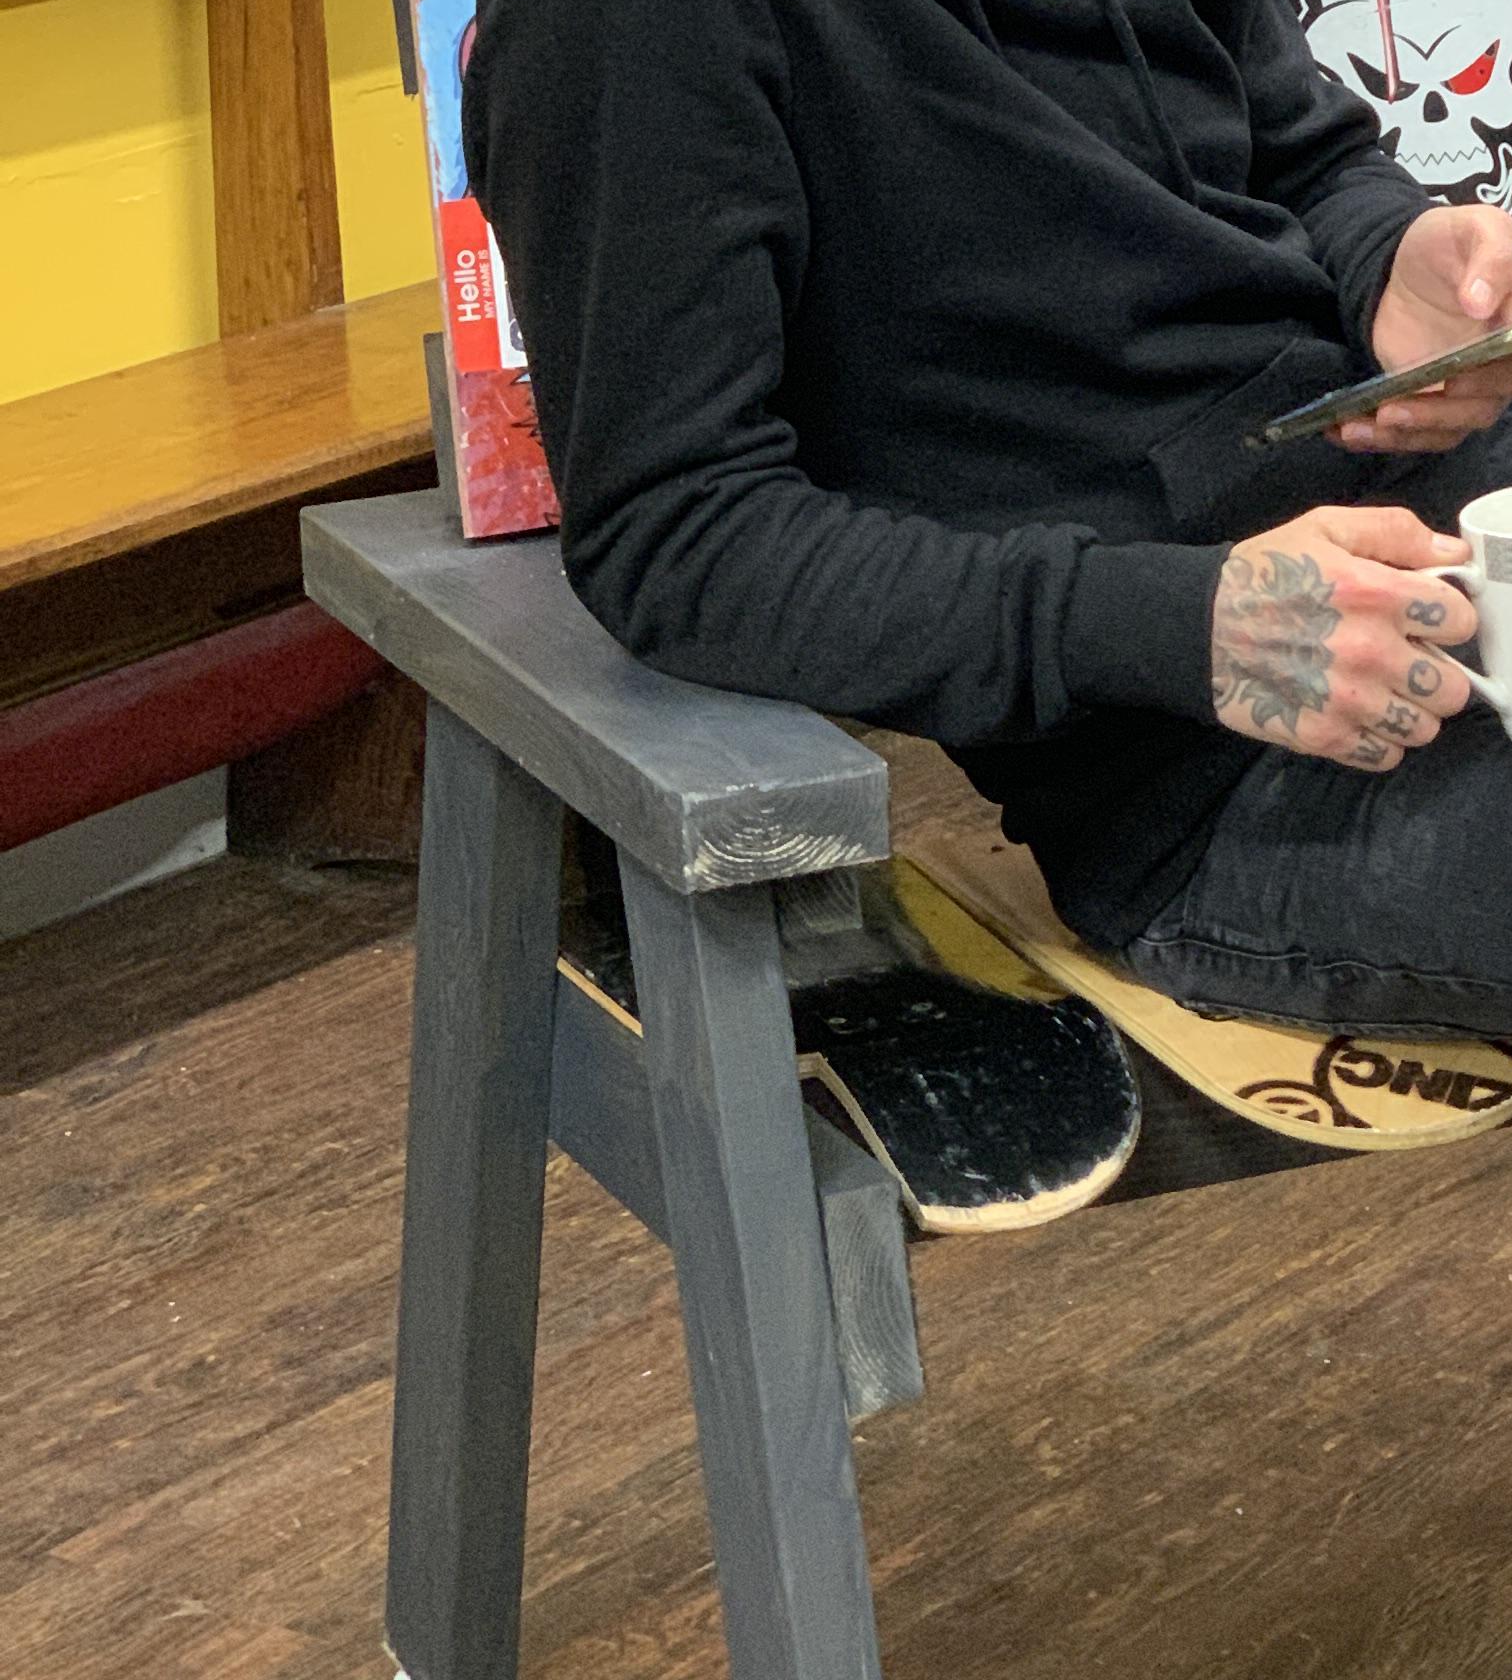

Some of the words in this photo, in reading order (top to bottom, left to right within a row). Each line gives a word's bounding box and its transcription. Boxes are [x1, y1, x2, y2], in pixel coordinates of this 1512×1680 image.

[477, 249, 488, 261] IS
[454, 249, 482, 322] Hello
[480, 262, 494, 297] NAME
[485, 300, 496, 319] MY
